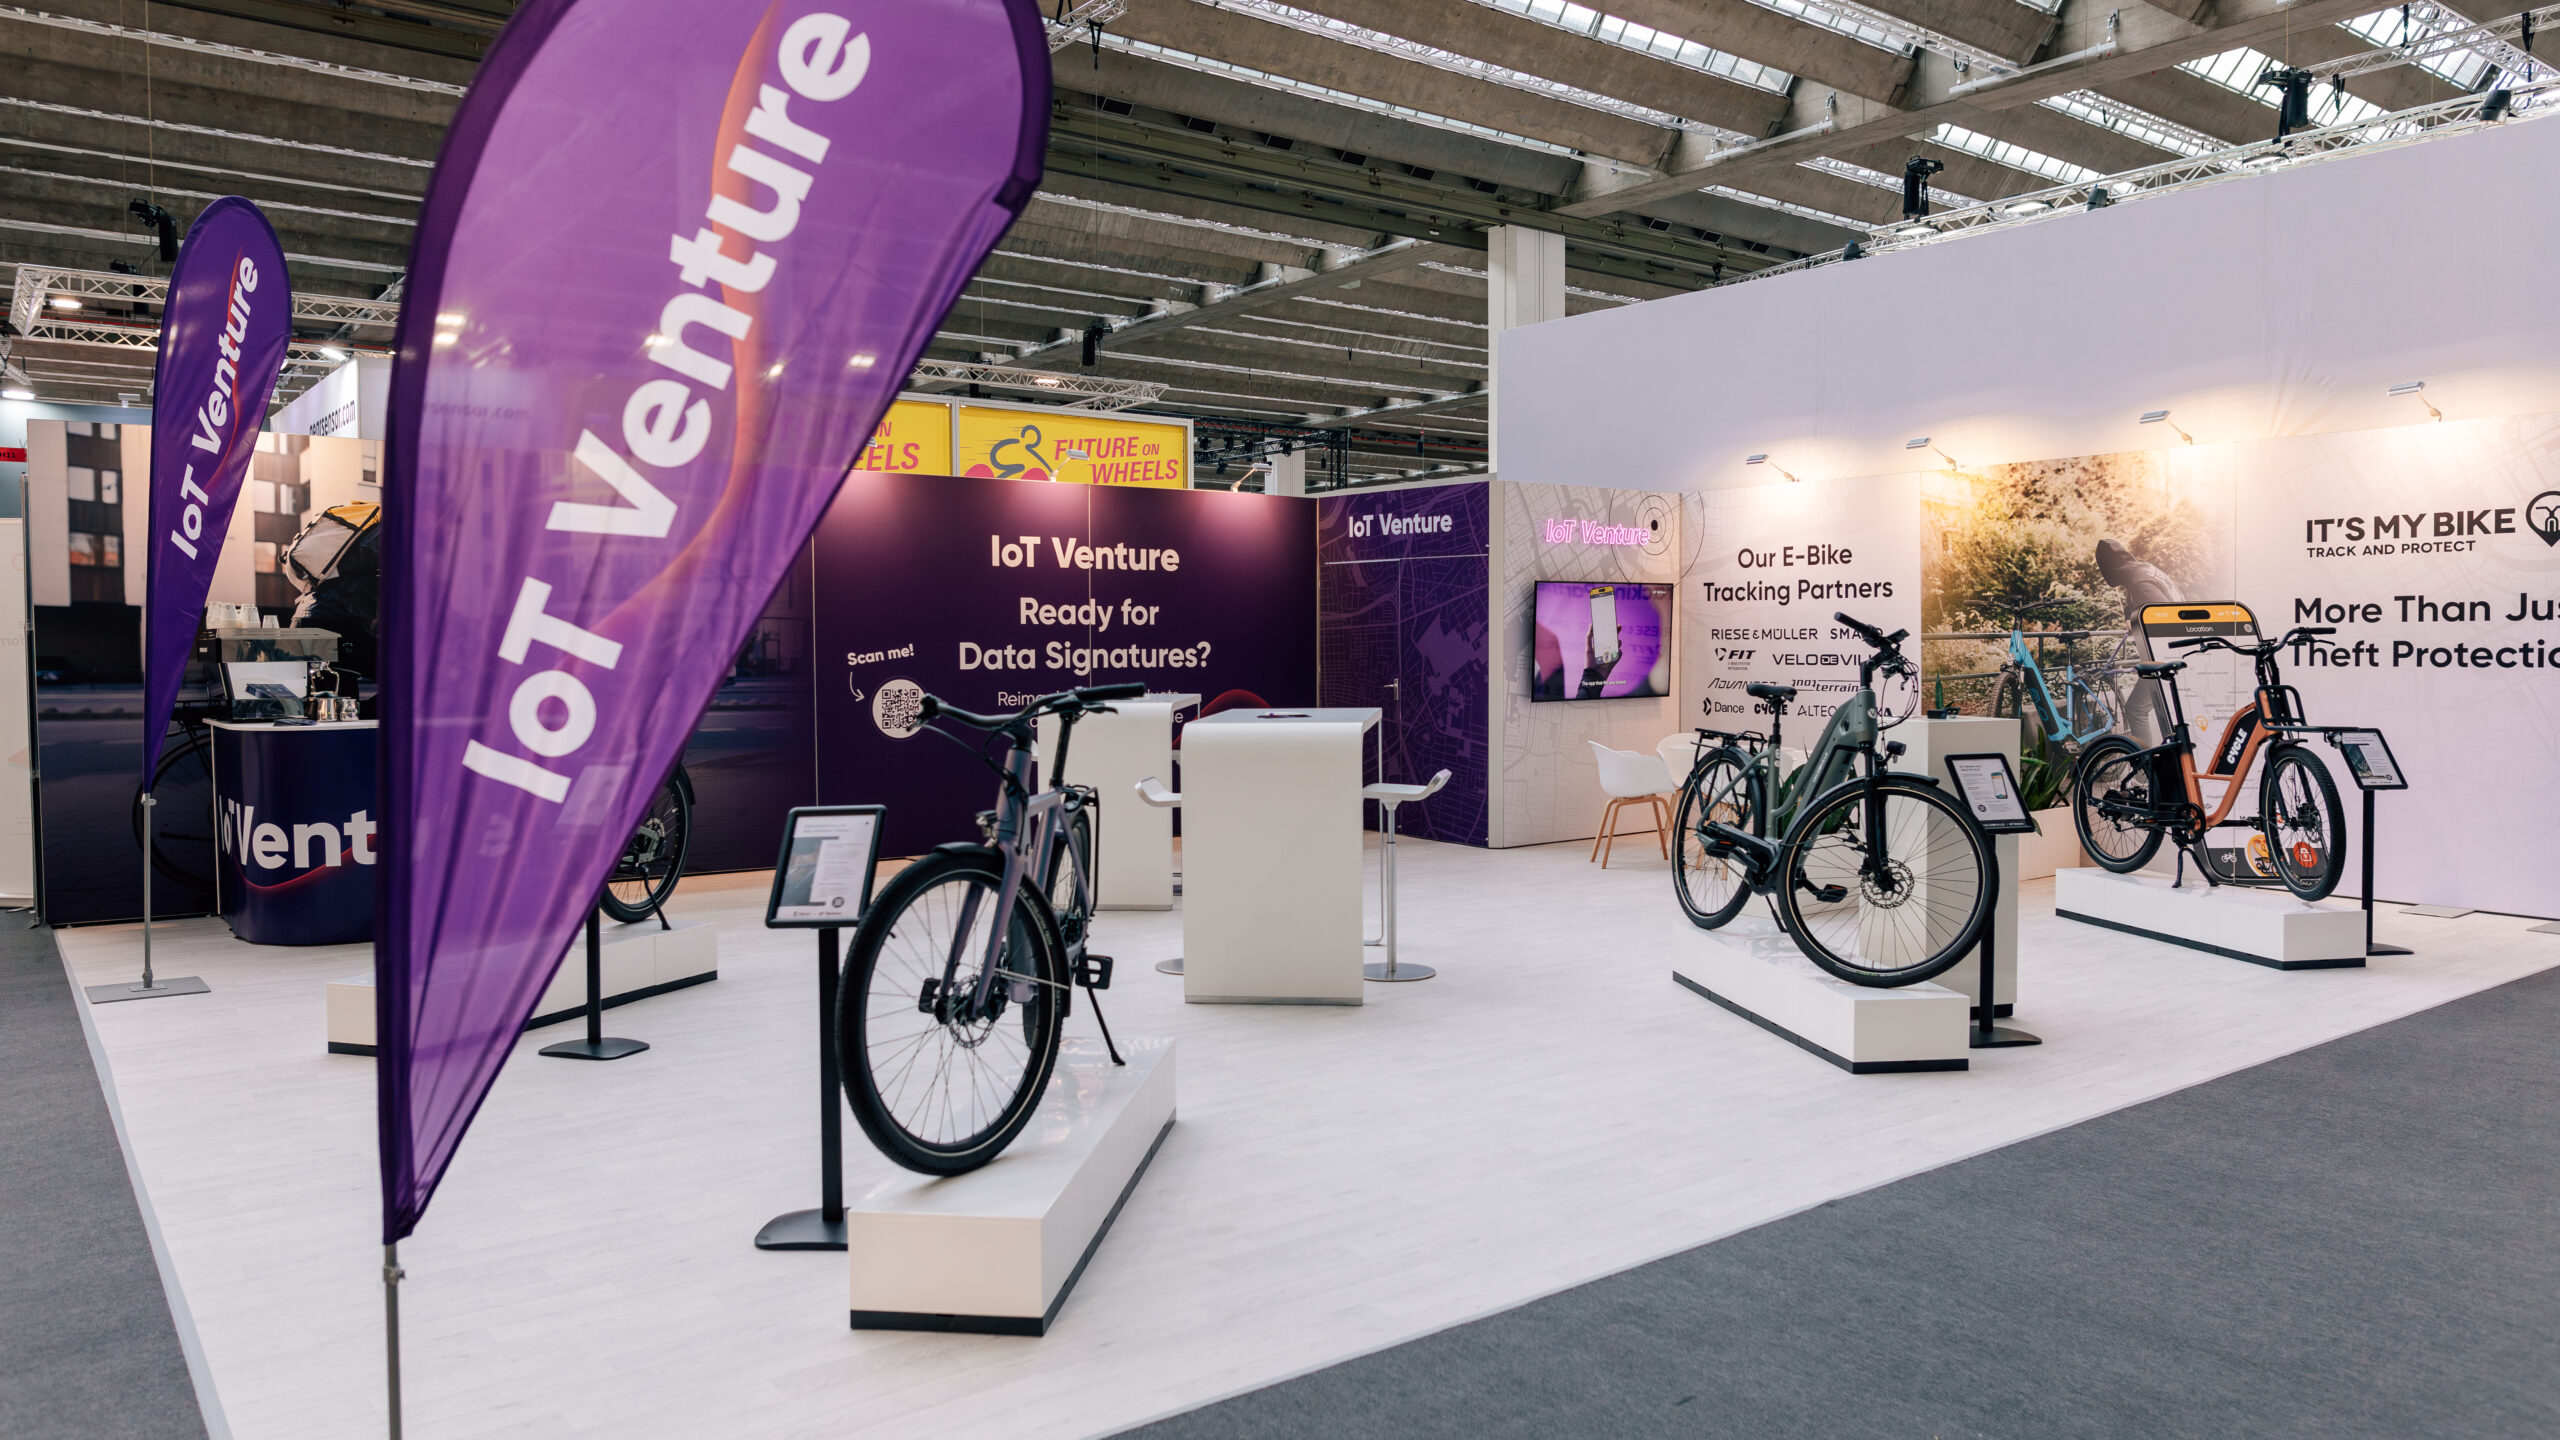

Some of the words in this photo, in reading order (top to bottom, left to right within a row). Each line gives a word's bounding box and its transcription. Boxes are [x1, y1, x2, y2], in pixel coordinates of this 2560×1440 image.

[171, 464, 209, 560] IoT
[192, 256, 258, 454] Venture
[462, 577, 624, 803] IoT
[545, 13, 871, 538] Venture
[853, 443, 920, 471] ELS
[1054, 436, 1139, 461] FUTURE
[1142, 443, 1160, 456] ON
[1090, 459, 1178, 484] WHEELS
[1349, 515, 1374, 538] IoT
[1379, 512, 1452, 536] Venture
[1546, 519, 1576, 543] IoT
[1581, 520, 1651, 546] Venture
[2306, 517, 2365, 543] IT'S
[2374, 513, 2426, 540] MY
[2433, 508, 2516, 537] BIKE
[991, 535, 1041, 568] IoT
[1051, 537, 1180, 572] Venture
[1737, 548, 1776, 568] Our
[1783, 544, 1853, 567] E-Bike
[2307, 546, 2357, 558] TRACK
[2362, 544, 2395, 556] AND
[2401, 540, 2476, 554] PROTECT
[1703, 581, 1790, 606] Tracking
[1798, 579, 1893, 600] Partners
[1020, 597, 1114, 632] Ready
[1121, 598, 1160, 625] for
[2294, 597, 2383, 624] More
[2394, 595, 2491, 622] Than
[2505, 592, 2560, 621] Ju
[1711, 629, 1750, 640] RIESE
[1761, 627, 1818, 640] MÜLLER
[1830, 628, 1883, 640] SMA
[2185, 625, 2214, 633] Location
[847, 651, 885, 666] Scan
[887, 643, 914, 660] me!
[959, 642, 1036, 670] Data
[1045, 641, 1212, 676] Signatures?
[1728, 650, 1757, 660] FIT
[2291, 640, 2380, 667] Theft
[1715, 702, 1745, 714] Dance
[2227, 728, 2248, 765] CYCLE
[235, 802, 377, 869] Vent
